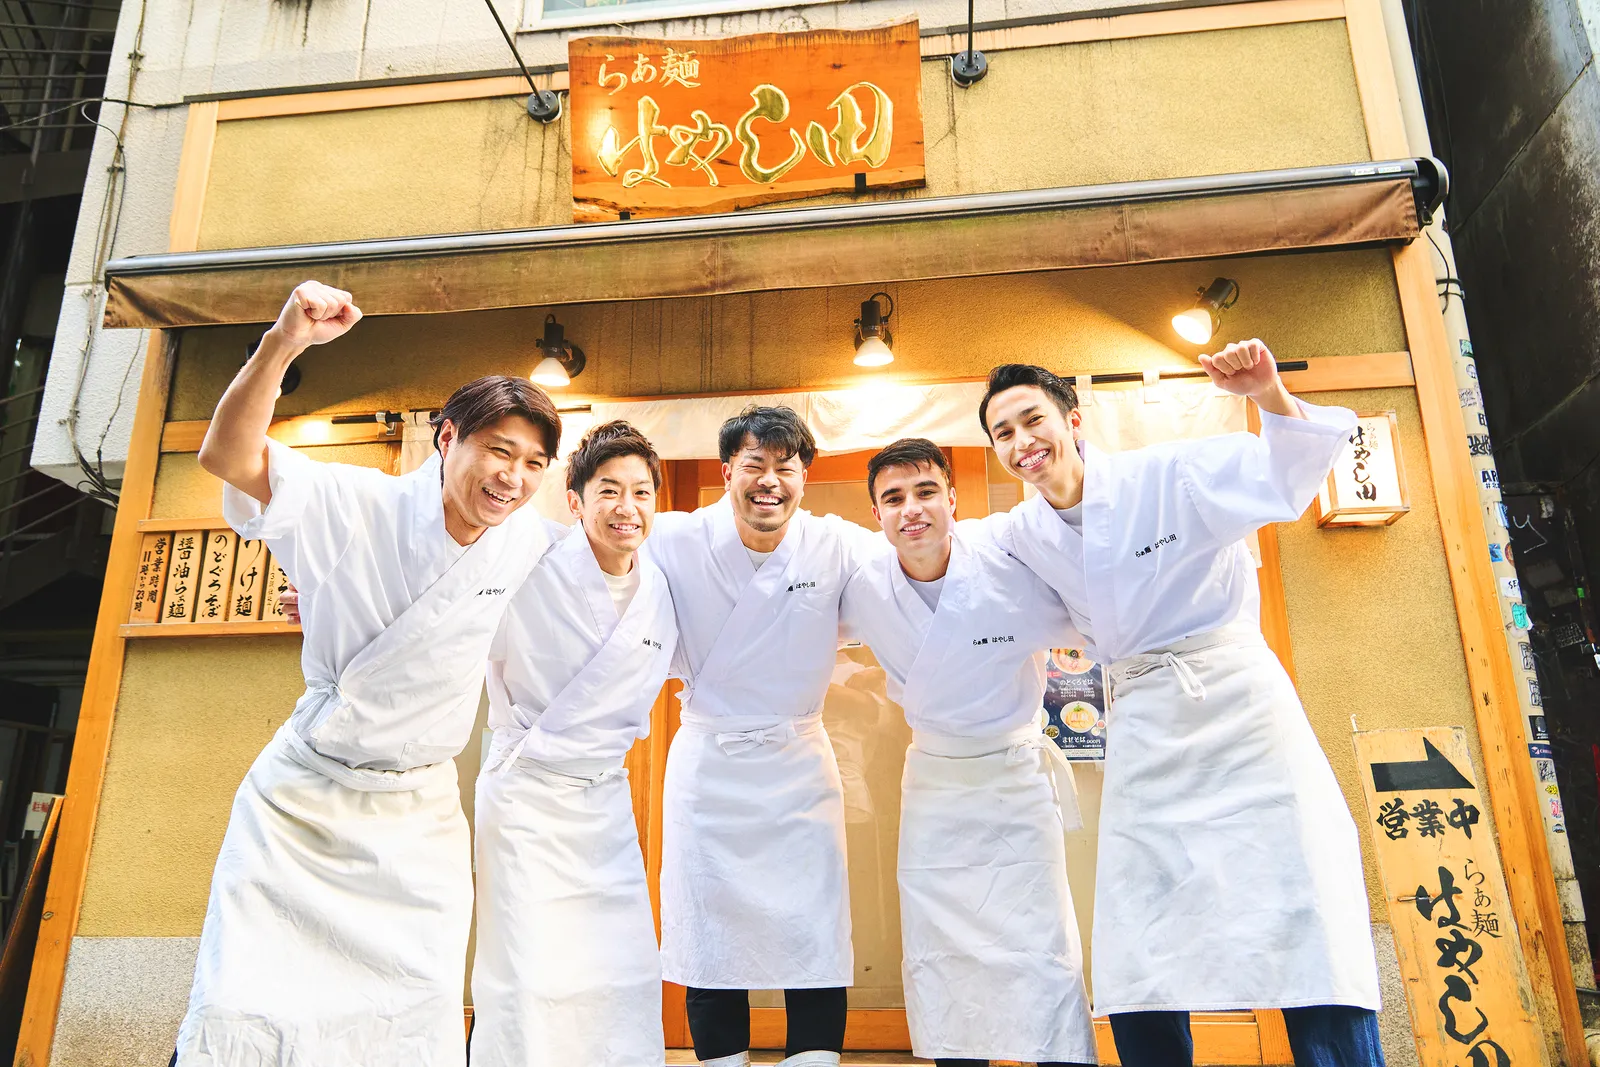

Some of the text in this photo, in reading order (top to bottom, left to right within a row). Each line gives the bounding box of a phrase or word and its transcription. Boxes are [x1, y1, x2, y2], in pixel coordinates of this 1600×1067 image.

[597, 82, 893, 189] はやし田
[1348, 425, 1377, 502] はやし田
[146, 537, 167, 604] 営業時間
[1154, 533, 1177, 549] はやし田
[201, 534, 228, 618] のどぐろそば
[991, 635, 1015, 643] はやし田
[1376, 797, 1481, 841] 営業中
